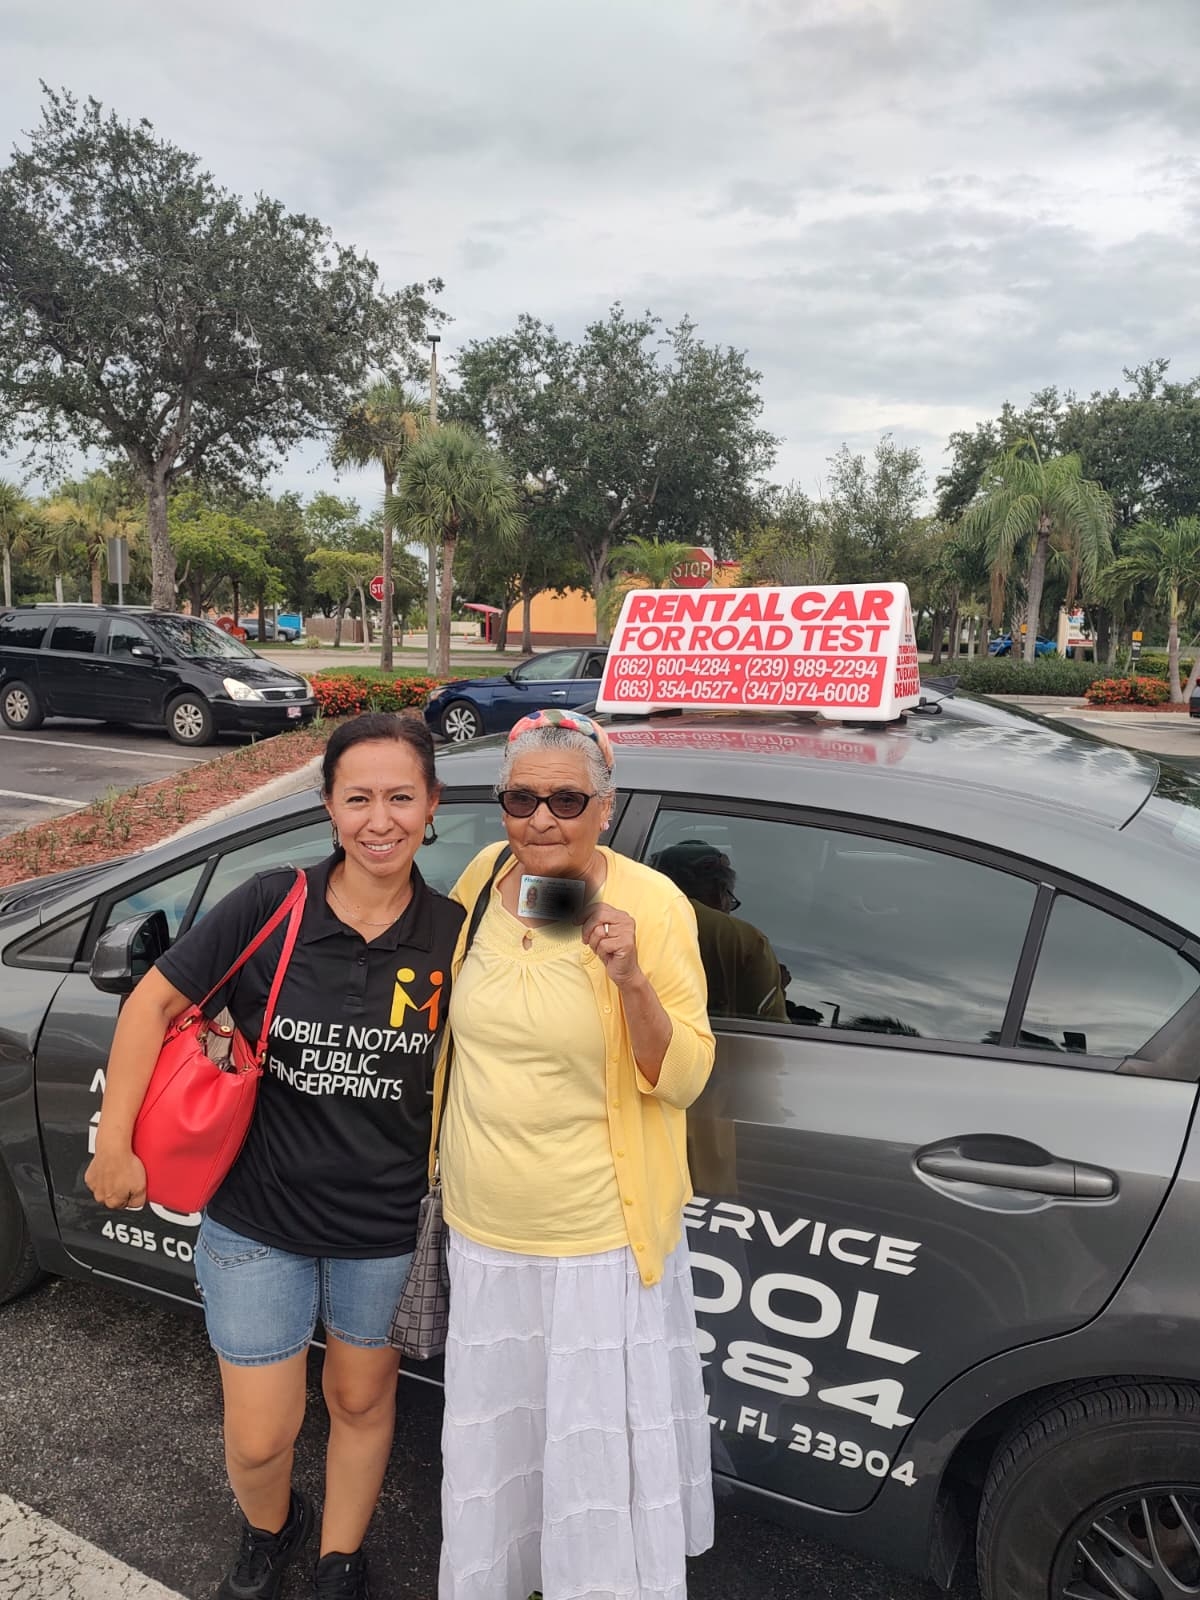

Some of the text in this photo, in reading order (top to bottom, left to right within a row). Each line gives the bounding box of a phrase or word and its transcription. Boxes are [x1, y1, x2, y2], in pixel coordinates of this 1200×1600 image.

[672, 561, 711, 578] STOP
[626, 590, 894, 623] RENTAL CAR
[619, 624, 890, 652] FOR ROAD TEST
[613, 657, 652, 678] (862)
[656, 657, 730, 676] 600-4284
[745, 657, 788, 680] (239)
[793, 659, 878, 679] 989-2294
[614, 679, 870, 704] (863) 354-0527 (347)974-6008
[346, 1026, 435, 1054] NOTARY
[301, 1049, 380, 1076] PUBLIC
[269, 1055, 403, 1101] FINGERPRINTS
[101, 1220, 193, 1262] 4635 CO
[682, 1196, 922, 1276] ERVICE
[689, 1251, 921, 1365] OOL
[737, 1406, 777, 1443] FL
[788, 1423, 918, 1487] 33904
